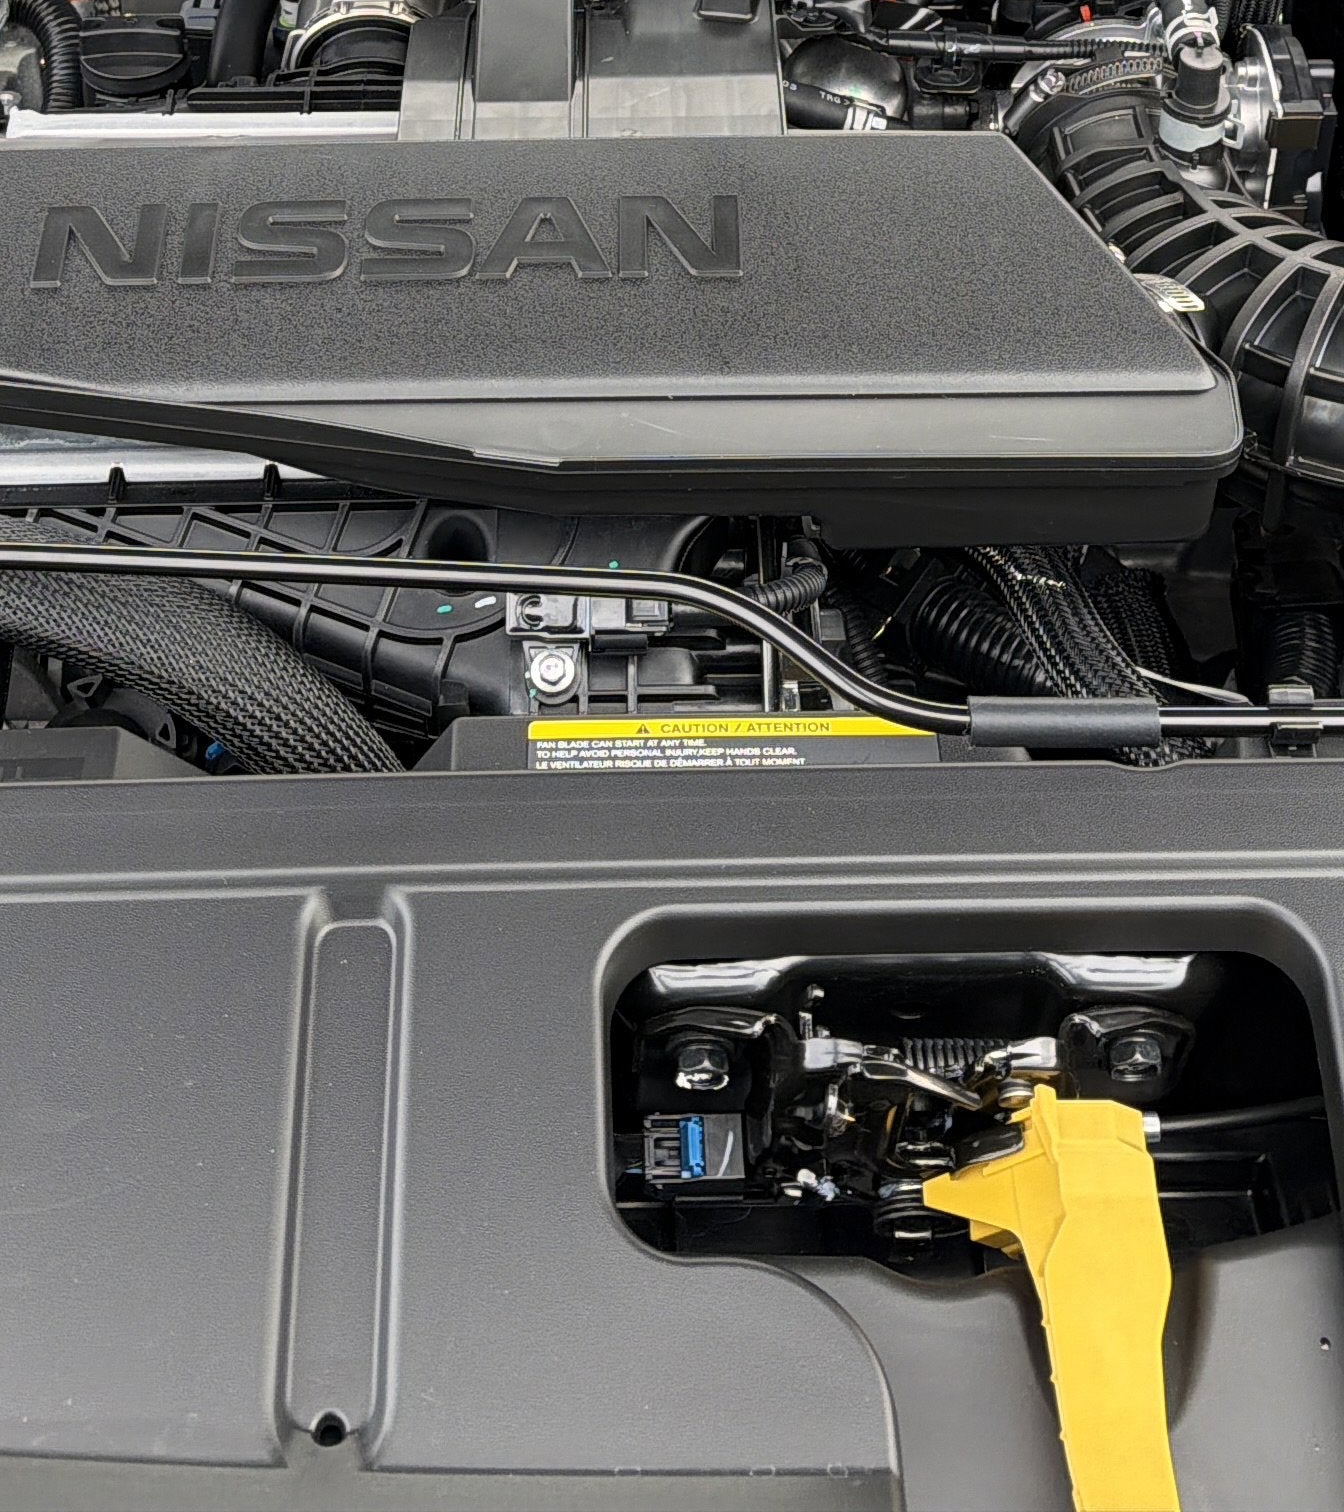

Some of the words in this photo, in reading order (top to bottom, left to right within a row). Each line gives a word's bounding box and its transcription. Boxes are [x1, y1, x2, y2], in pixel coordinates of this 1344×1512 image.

[31, 194, 744, 288] NISSAN
[661, 723, 729, 734] CAUTION
[747, 722, 830, 733] ATTENTION
[537, 740, 556, 749] FAN
[558, 740, 590, 749] BLADE
[591, 740, 613, 748] CAN
[615, 739, 645, 748] START
[647, 739, 659, 747] AT
[661, 738, 681, 747] ANY
[536, 750, 551, 759] TO
[553, 750, 578, 758] HELP
[579, 749, 610, 758] AVOID
[611, 749, 663, 757] PERSONAL
[726, 747, 761, 756] HANDS
[762, 747, 797, 755] CLEAR.
[536, 760, 549, 770] LE
[550, 760, 613, 769] VENTILATEUR
[615, 759, 652, 768] RISQUE
[654, 759, 668, 768] DE
[669, 757, 723, 767] DÉMARRER
[735, 758, 760, 766] TOUT
[761, 757, 806, 766] MOMENT
